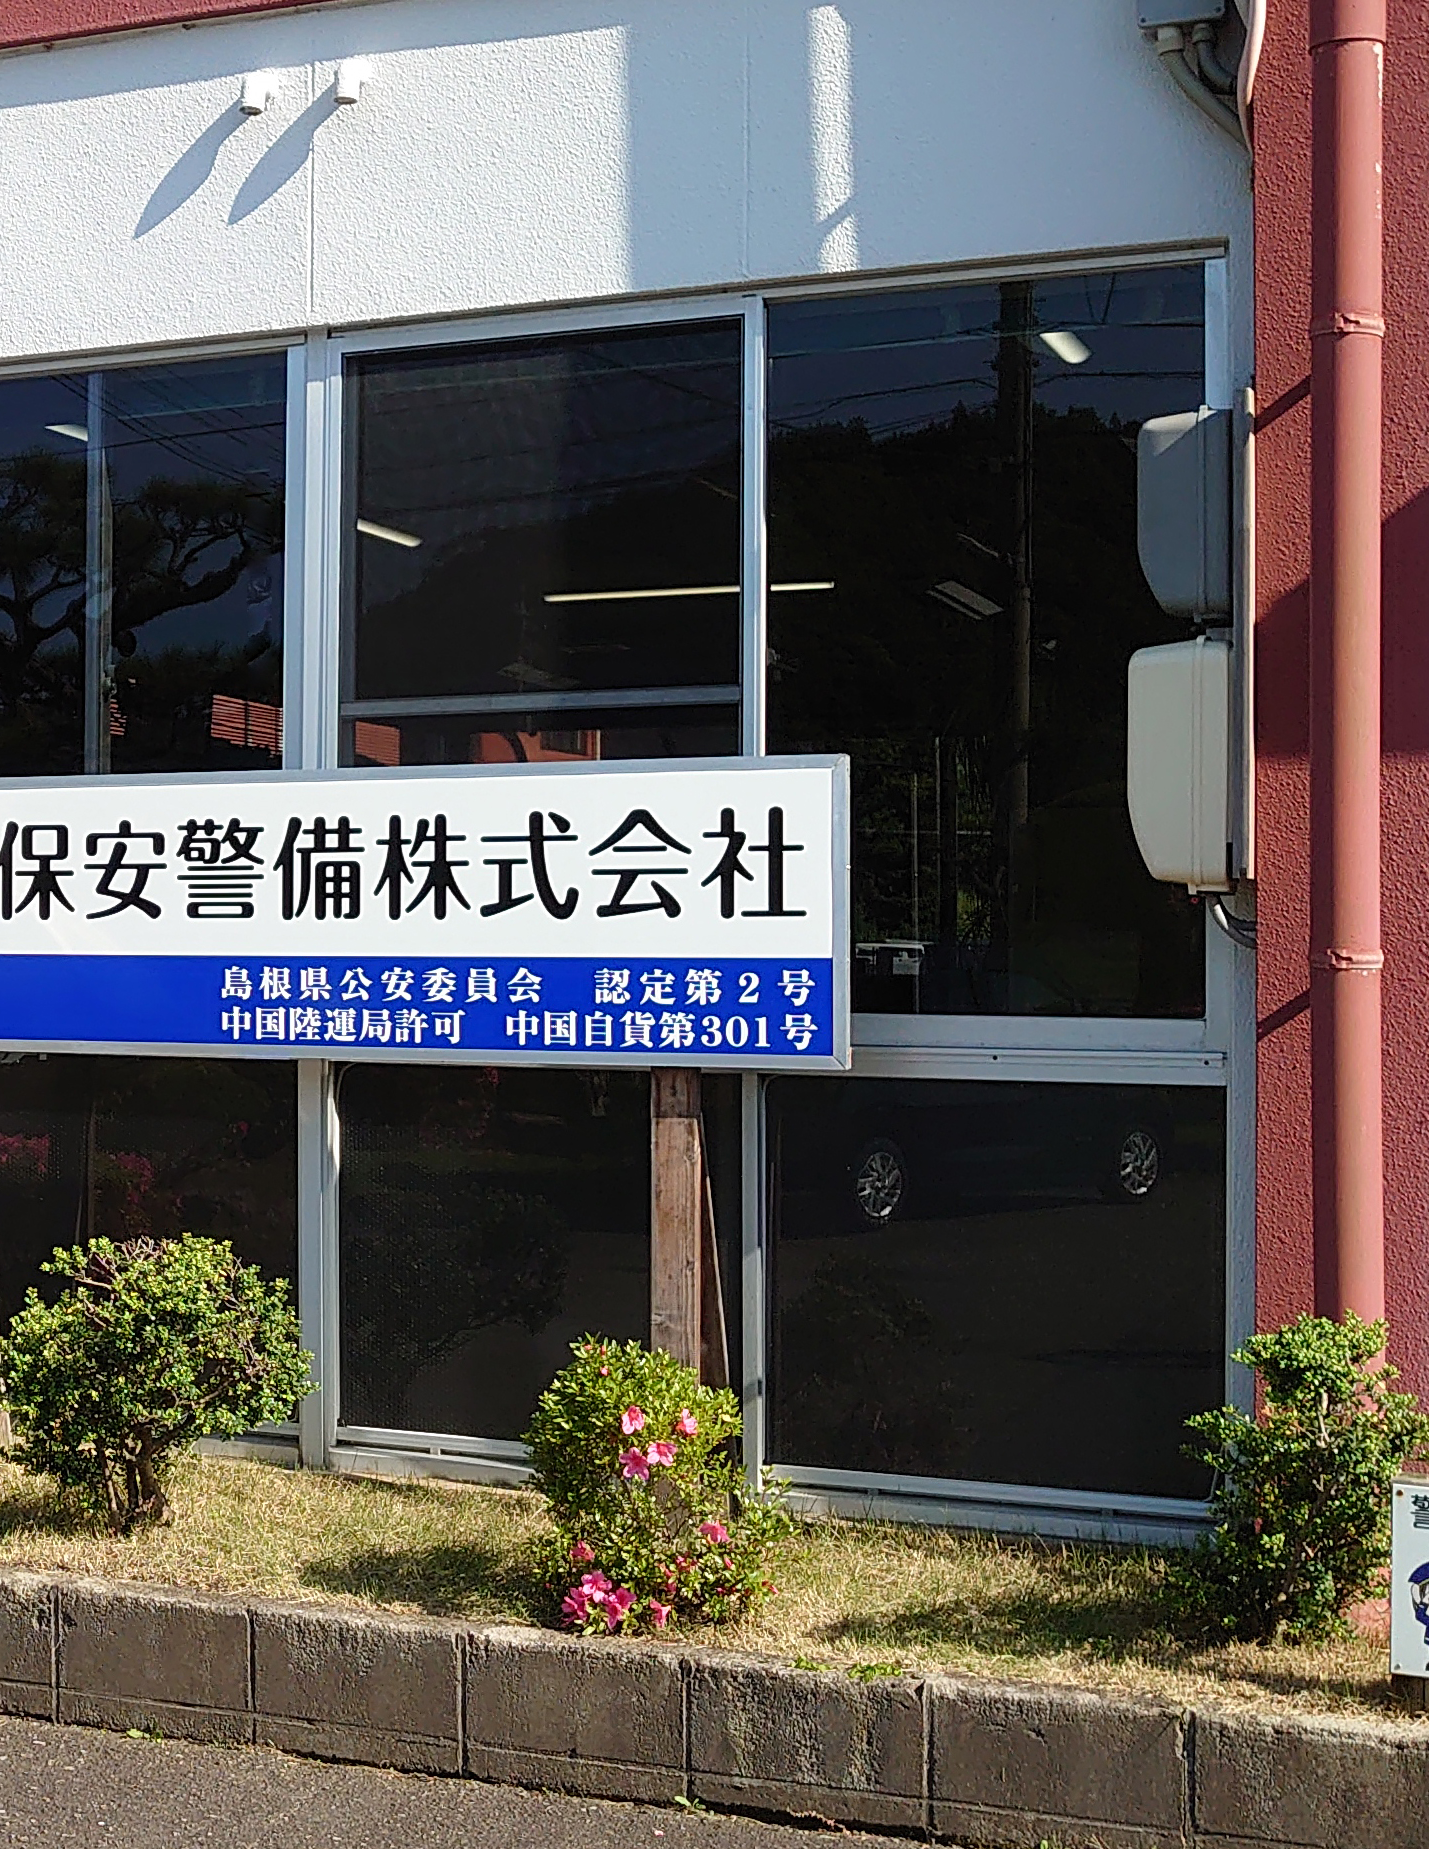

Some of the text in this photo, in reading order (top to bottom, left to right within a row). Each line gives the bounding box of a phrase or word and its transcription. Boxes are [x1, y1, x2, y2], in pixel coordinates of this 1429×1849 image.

[221, 966, 543, 1004] 島根県公安委員会
[221, 1007, 819, 1049] 中国陸運局許可 中国自貨第301号
